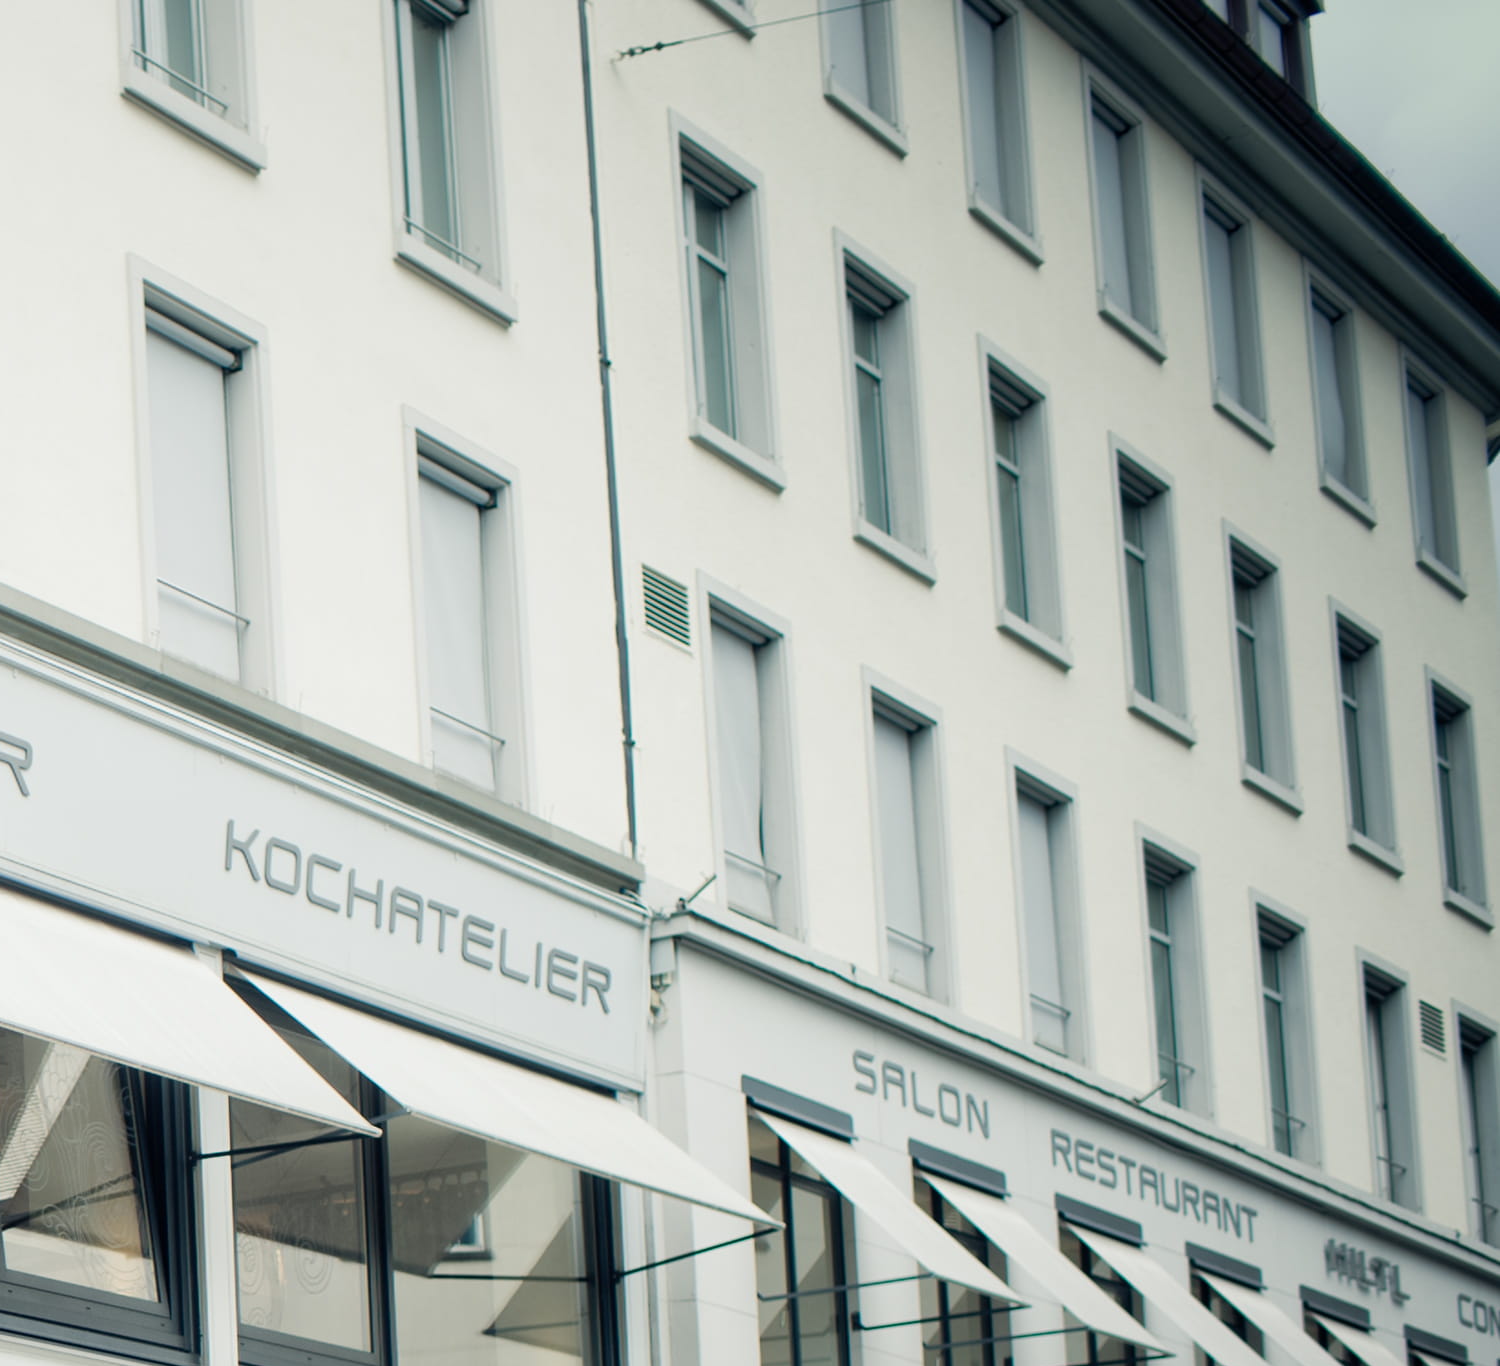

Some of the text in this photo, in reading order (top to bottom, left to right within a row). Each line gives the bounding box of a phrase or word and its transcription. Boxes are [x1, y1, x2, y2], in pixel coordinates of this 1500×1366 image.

[225, 819, 612, 1014] KOCHATELIER
[853, 1049, 1257, 1243] SALON RESTAURANT
